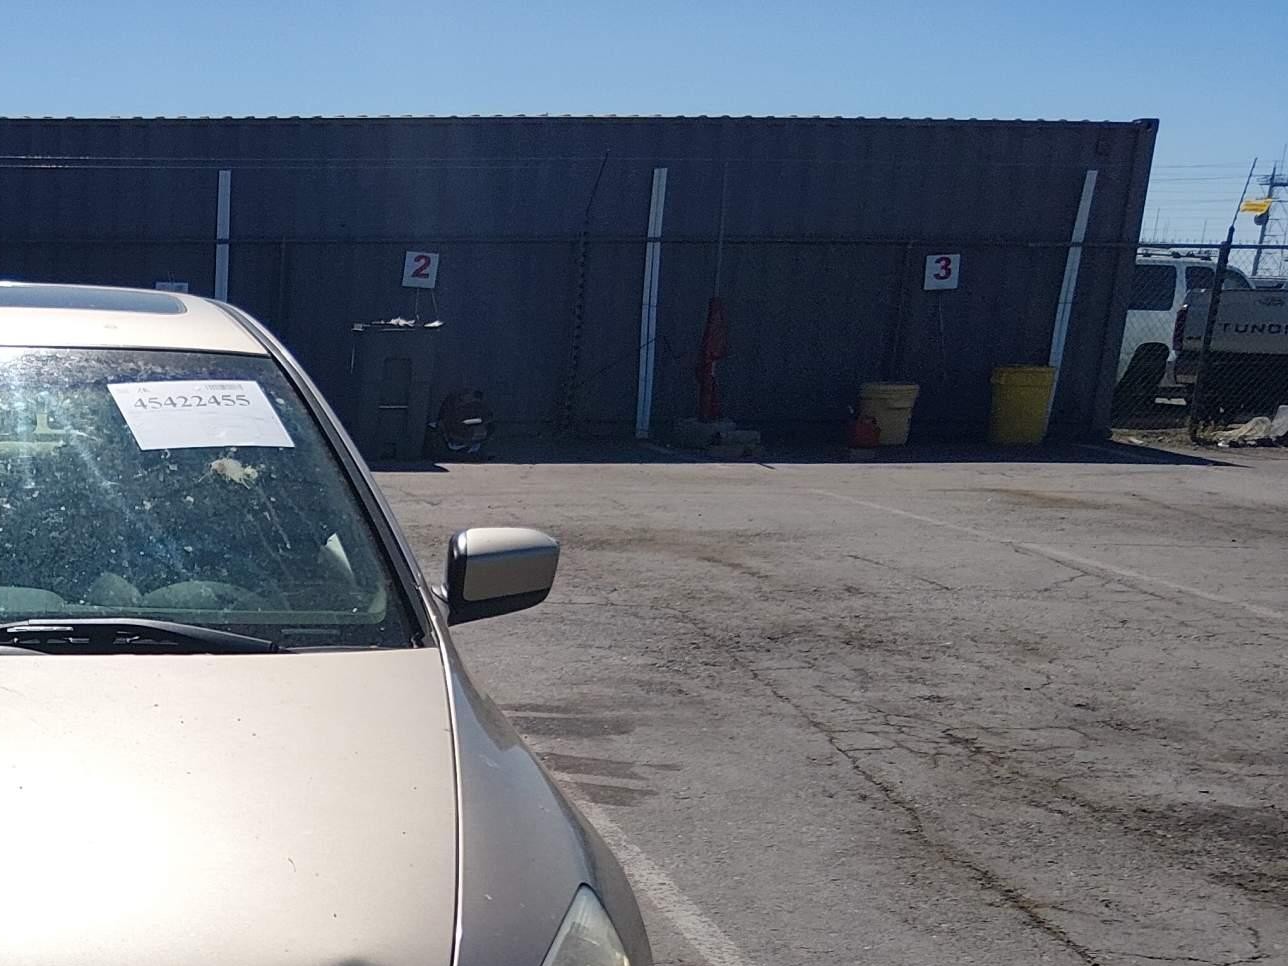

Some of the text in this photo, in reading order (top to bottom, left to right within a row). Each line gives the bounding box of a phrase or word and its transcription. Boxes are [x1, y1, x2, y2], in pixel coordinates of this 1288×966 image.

[411, 255, 431, 279] 2
[933, 256, 952, 281] 3
[133, 394, 251, 410] 45422455
